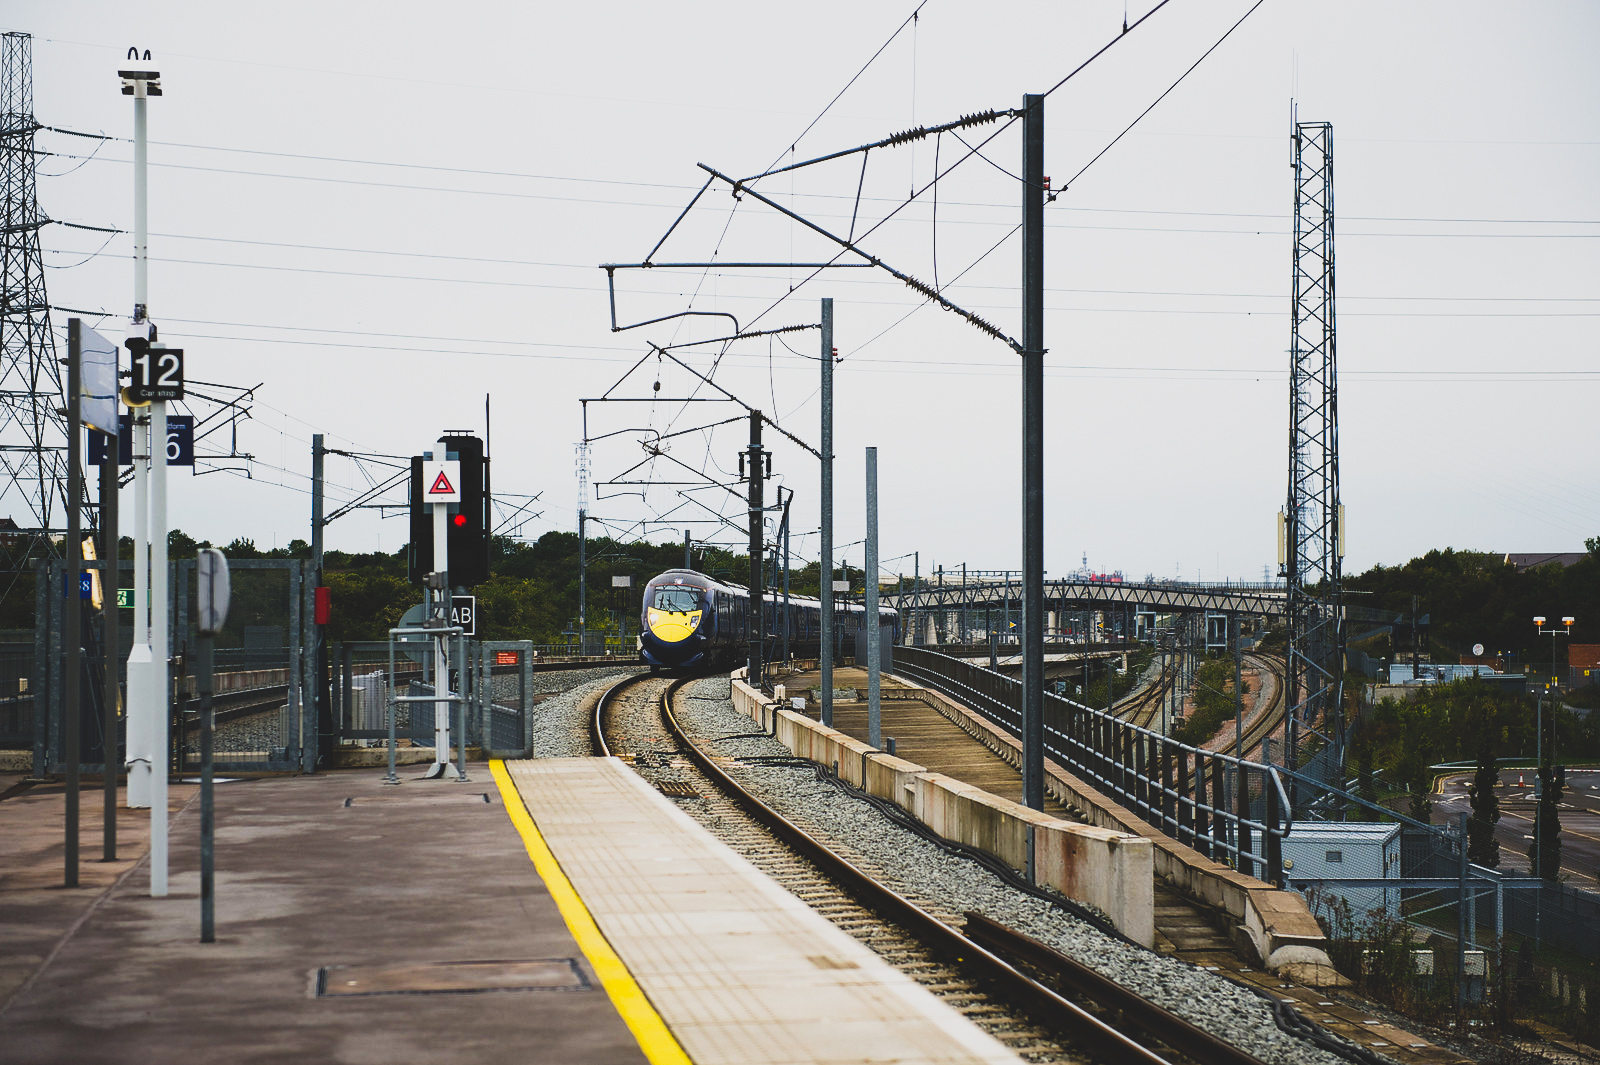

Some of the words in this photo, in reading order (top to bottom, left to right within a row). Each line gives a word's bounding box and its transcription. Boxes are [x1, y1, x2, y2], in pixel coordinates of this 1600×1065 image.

[135, 354, 180, 386] 12
[166, 433, 180, 460] 6
[452, 607, 471, 624] AB
